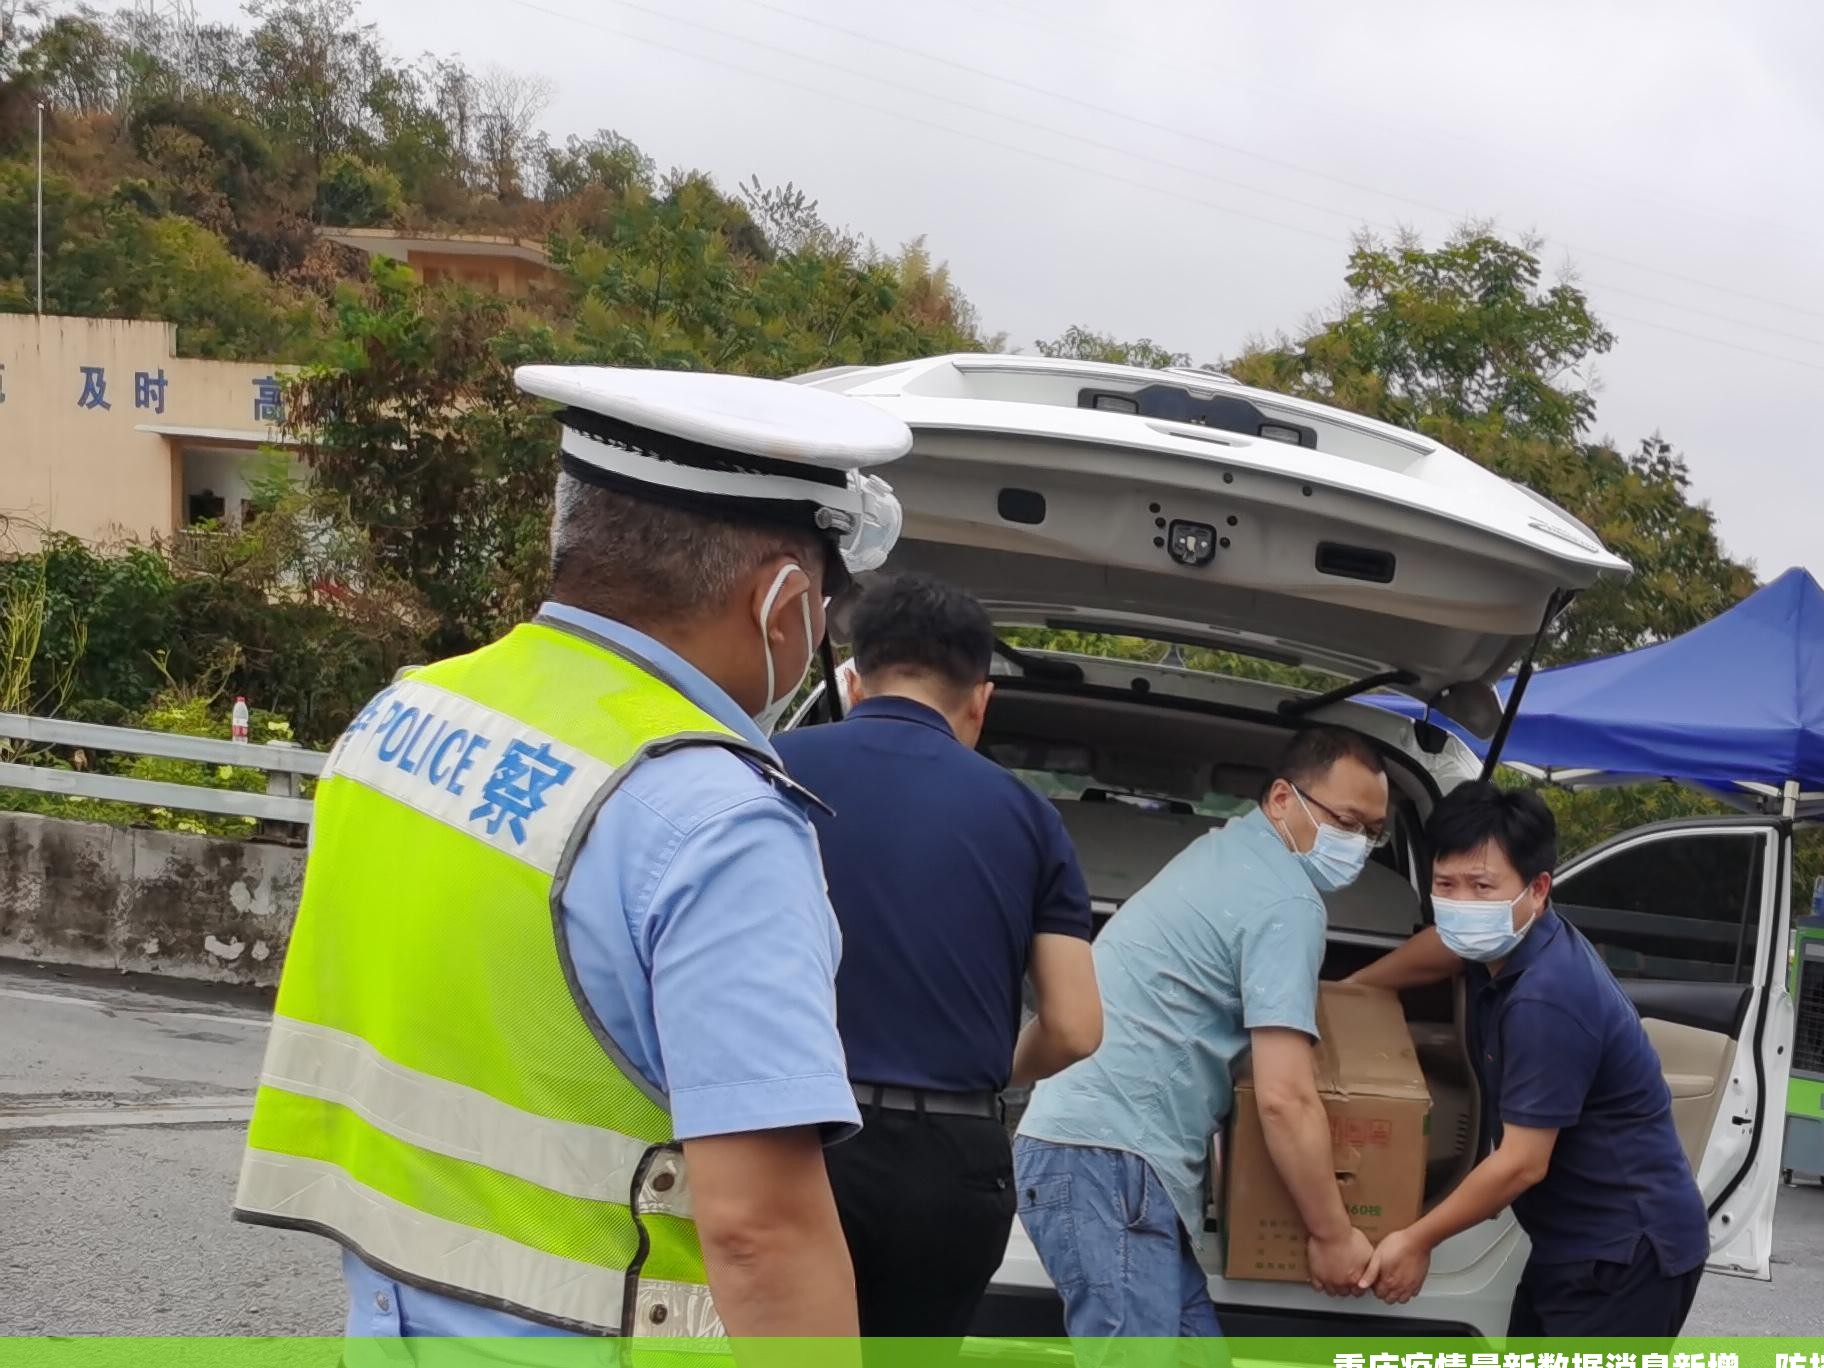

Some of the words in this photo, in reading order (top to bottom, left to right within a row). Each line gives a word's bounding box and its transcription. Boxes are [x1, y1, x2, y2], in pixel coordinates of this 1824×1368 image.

[77, 366, 168, 414] 及时
[374, 699, 491, 796] POLICE
[469, 738, 577, 846] 察
